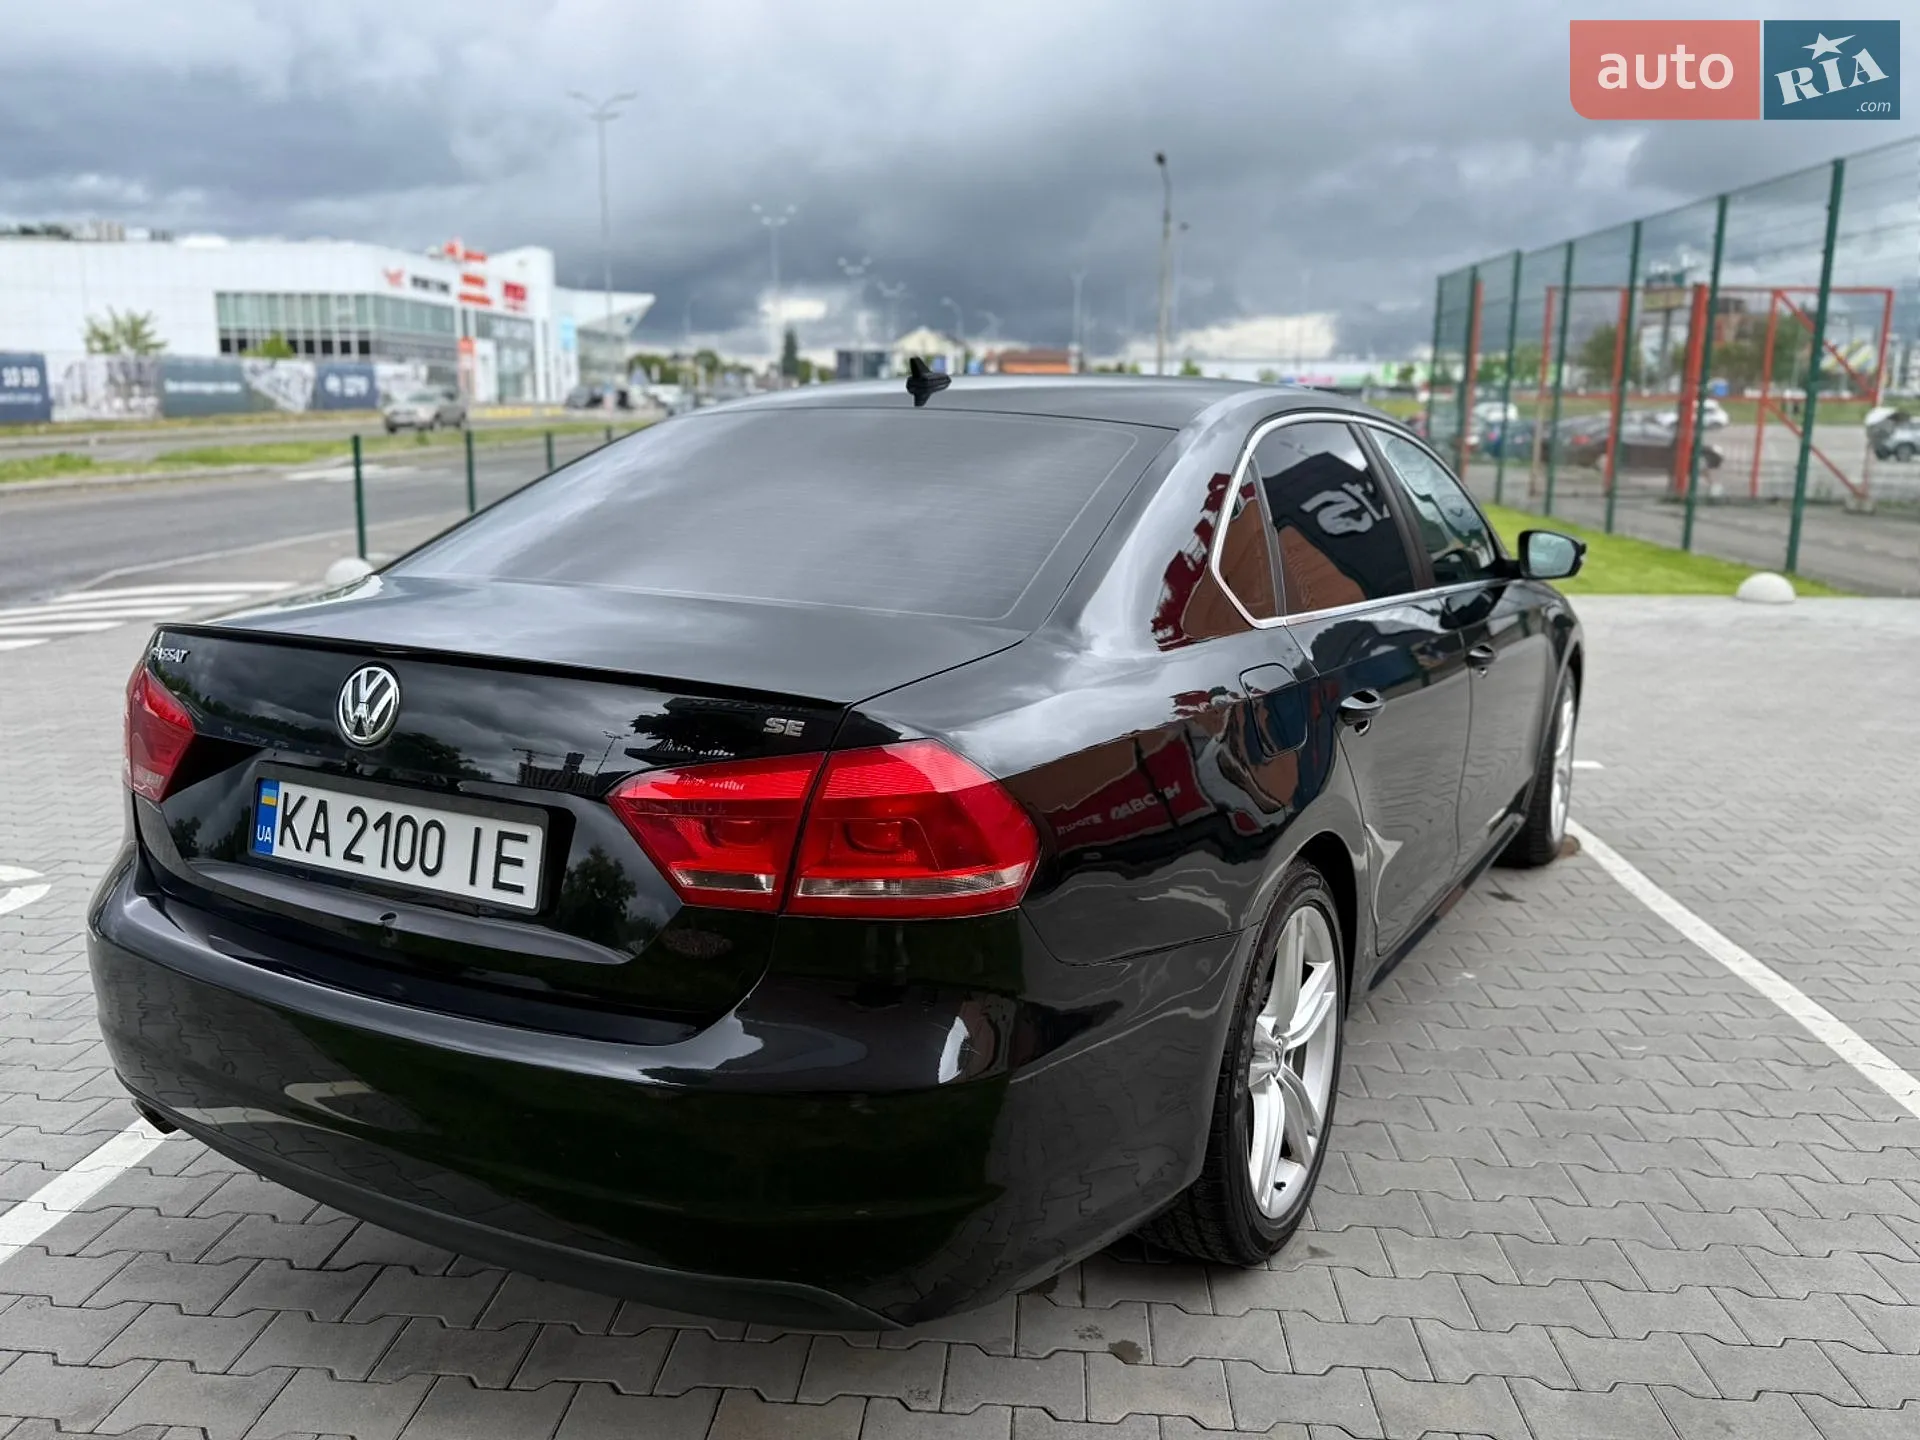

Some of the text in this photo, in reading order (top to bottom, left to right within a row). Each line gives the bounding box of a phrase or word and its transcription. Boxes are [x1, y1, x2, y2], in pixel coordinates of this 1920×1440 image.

[763, 717, 805, 737] SE
[256, 824, 273, 844] UA
[278, 791, 529, 895] KA 2100 IE
